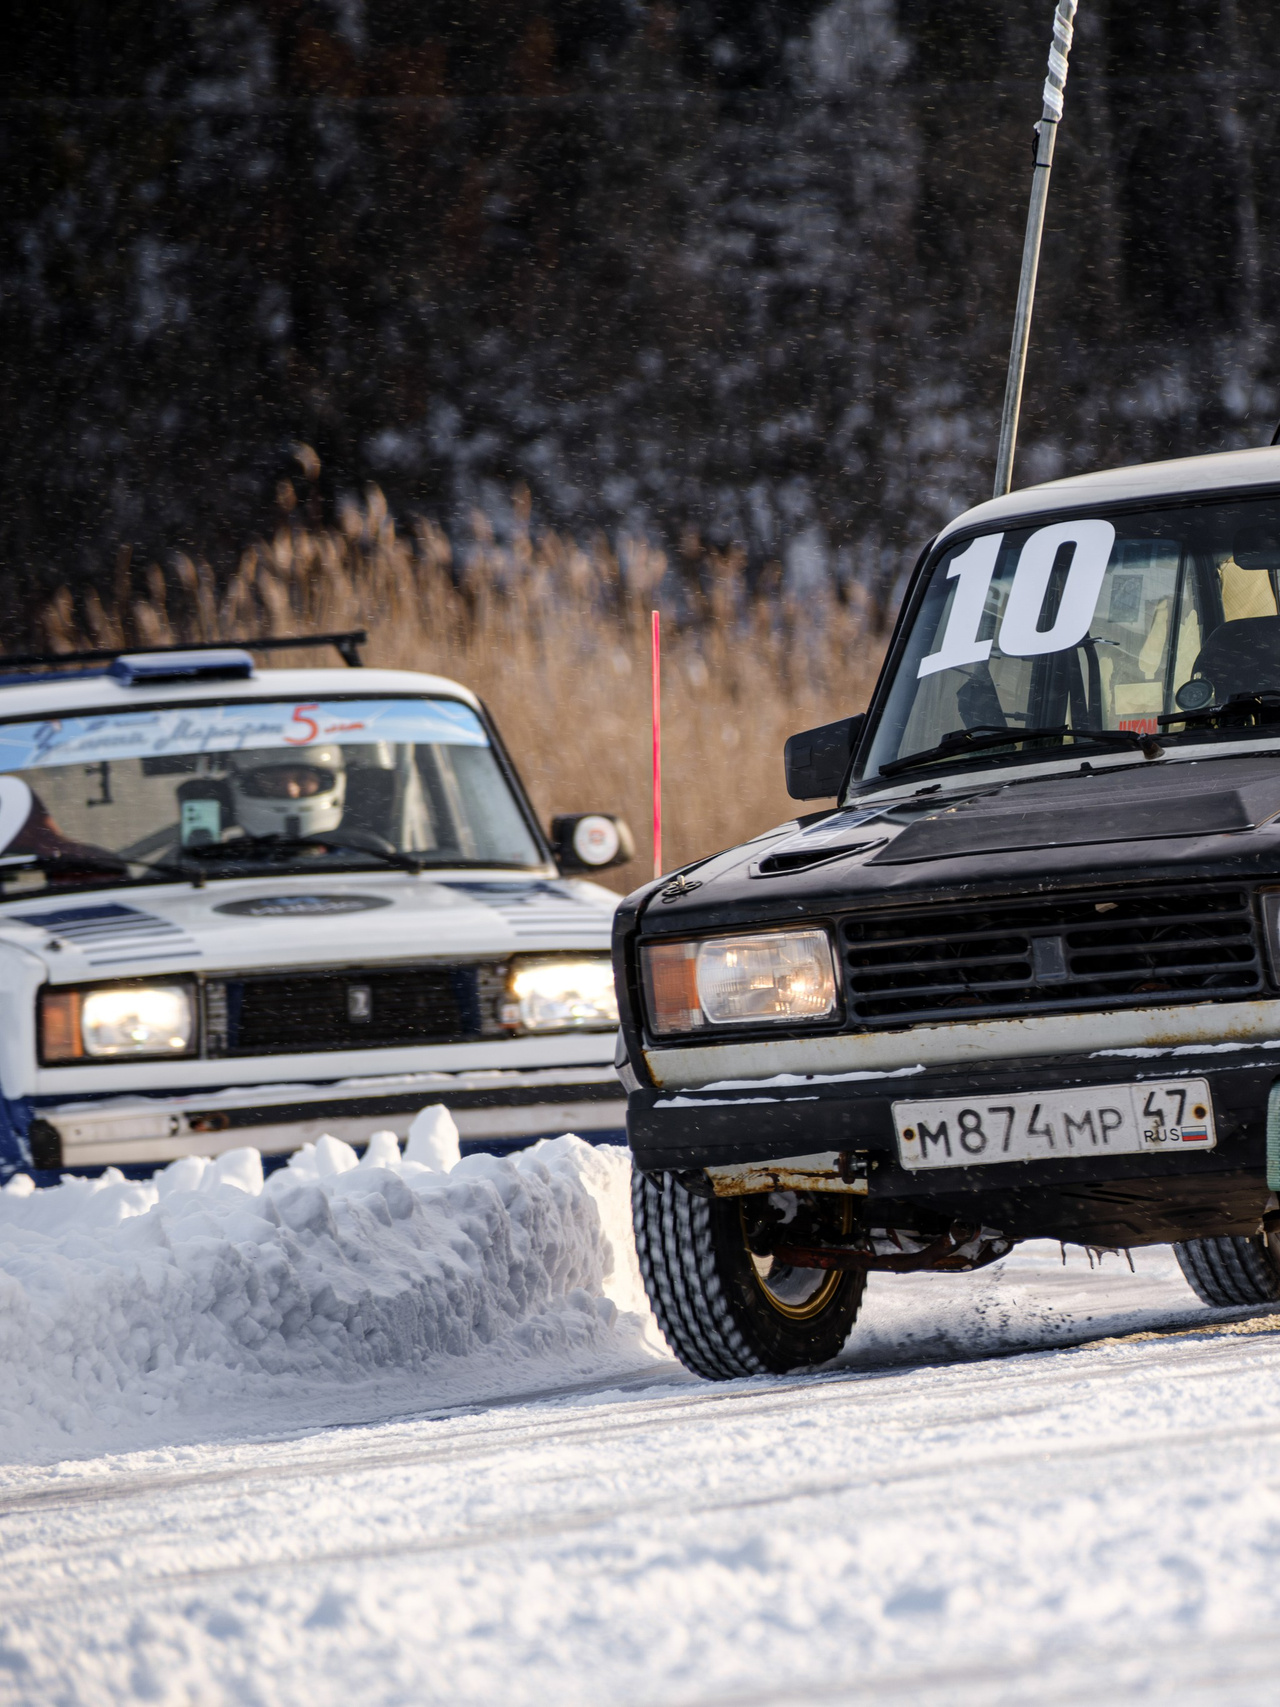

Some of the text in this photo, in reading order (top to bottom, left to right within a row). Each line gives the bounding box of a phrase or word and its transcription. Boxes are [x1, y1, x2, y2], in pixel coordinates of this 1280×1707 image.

[917, 519, 1116, 679] 10
[283, 704, 319, 746] 5
[1142, 1089, 1188, 1126] 47
[1144, 1128, 1180, 1143] RUS
